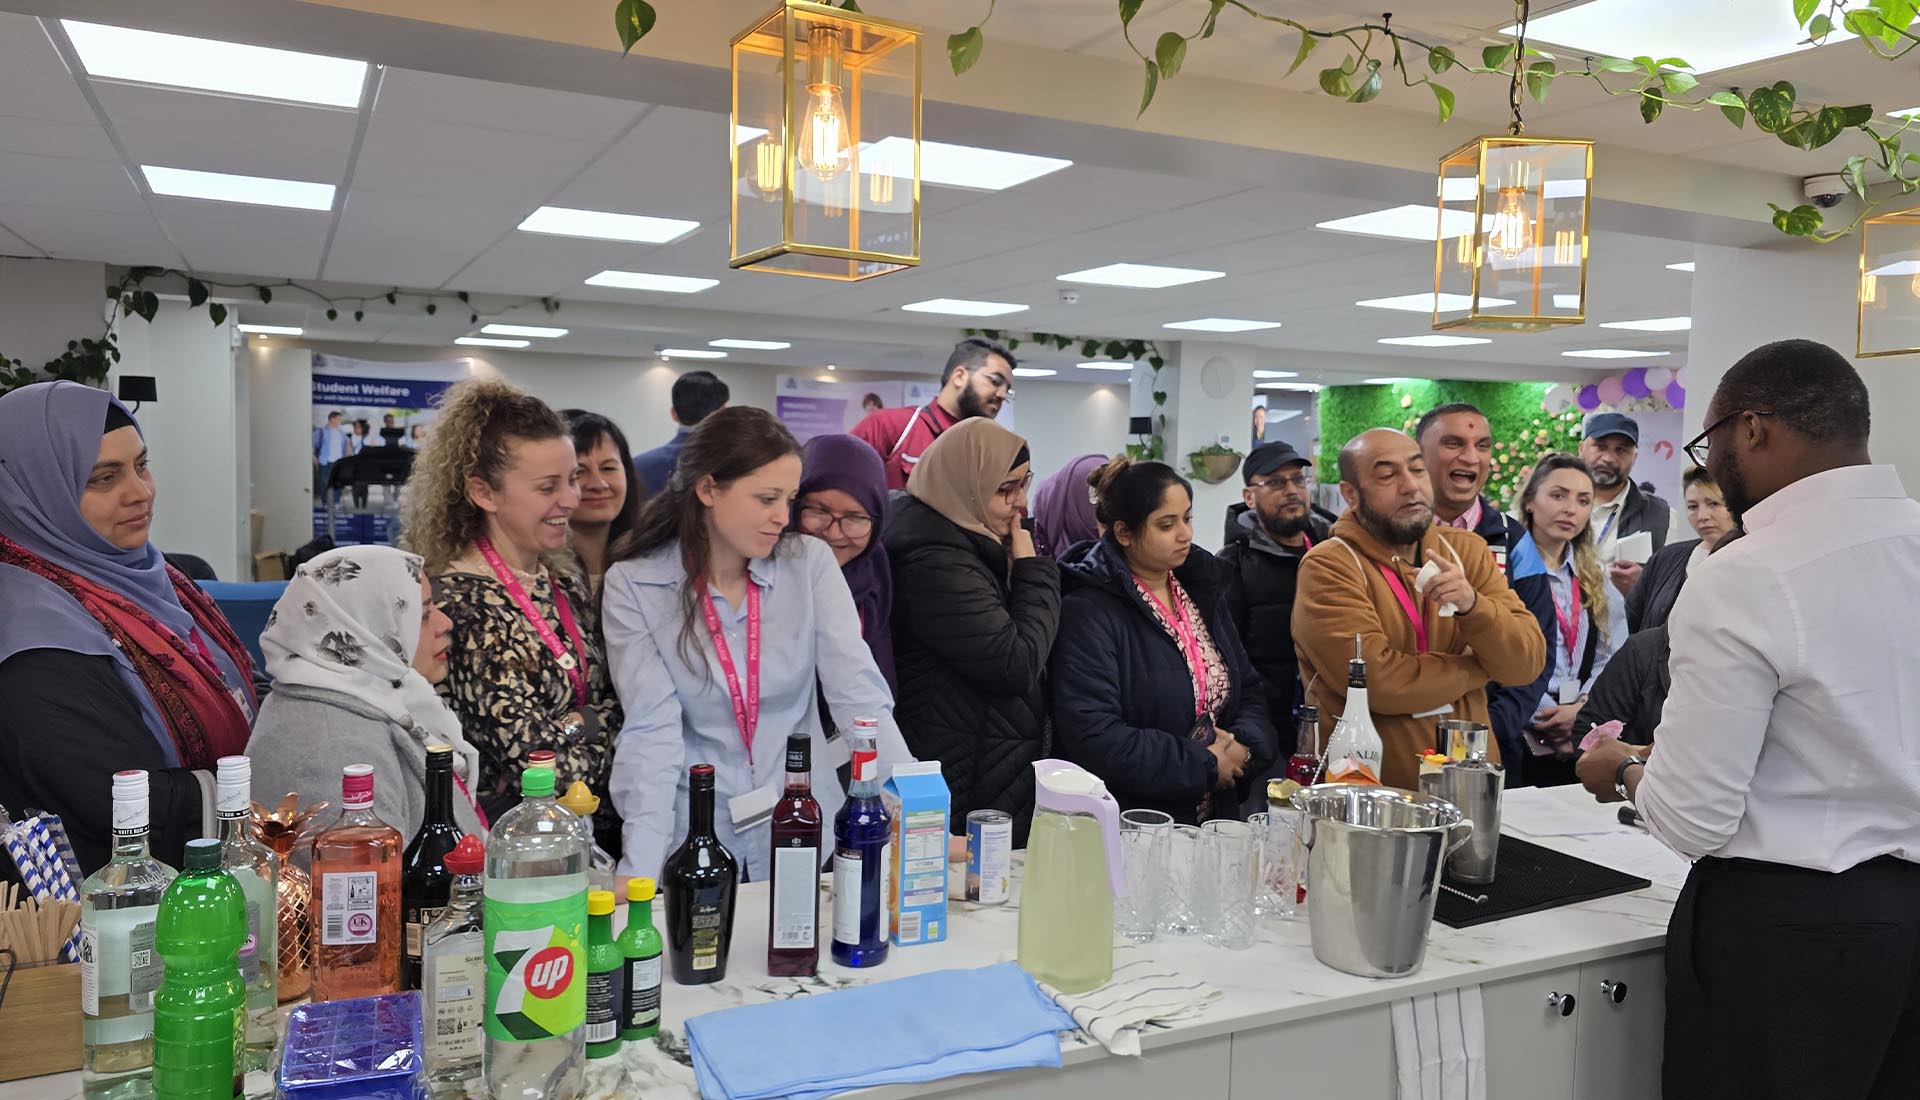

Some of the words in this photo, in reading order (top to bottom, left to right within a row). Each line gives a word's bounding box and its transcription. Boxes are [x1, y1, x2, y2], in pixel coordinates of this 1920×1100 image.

[312, 381, 359, 394] Student
[361, 384, 410, 397] Welfare
[353, 918, 368, 926] UK
